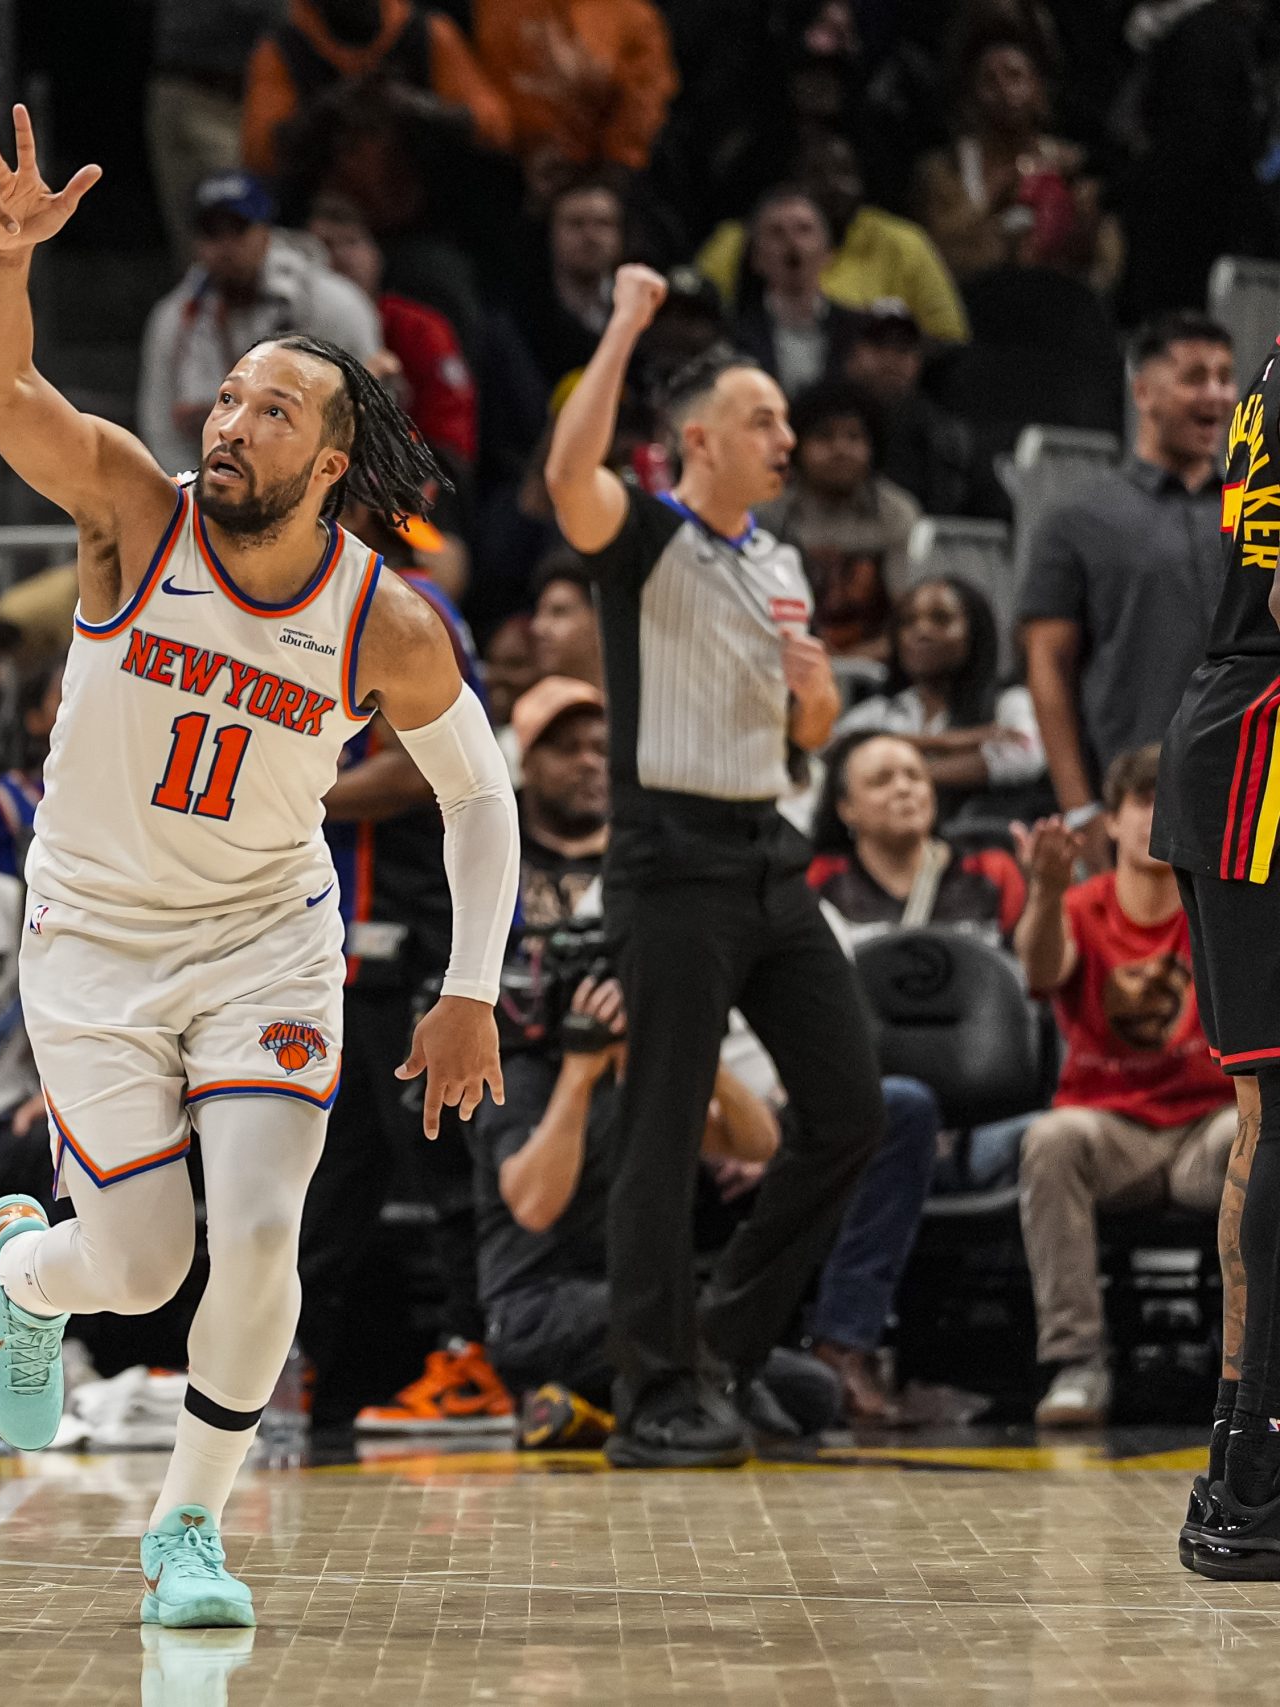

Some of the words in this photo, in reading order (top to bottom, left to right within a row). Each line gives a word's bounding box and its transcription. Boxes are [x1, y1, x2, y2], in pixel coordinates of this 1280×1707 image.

[279, 635, 302, 647] abu
[303, 640, 337, 656] dhabi
[151, 711, 252, 822] 11
[259, 1022, 327, 1058] KNICKS
